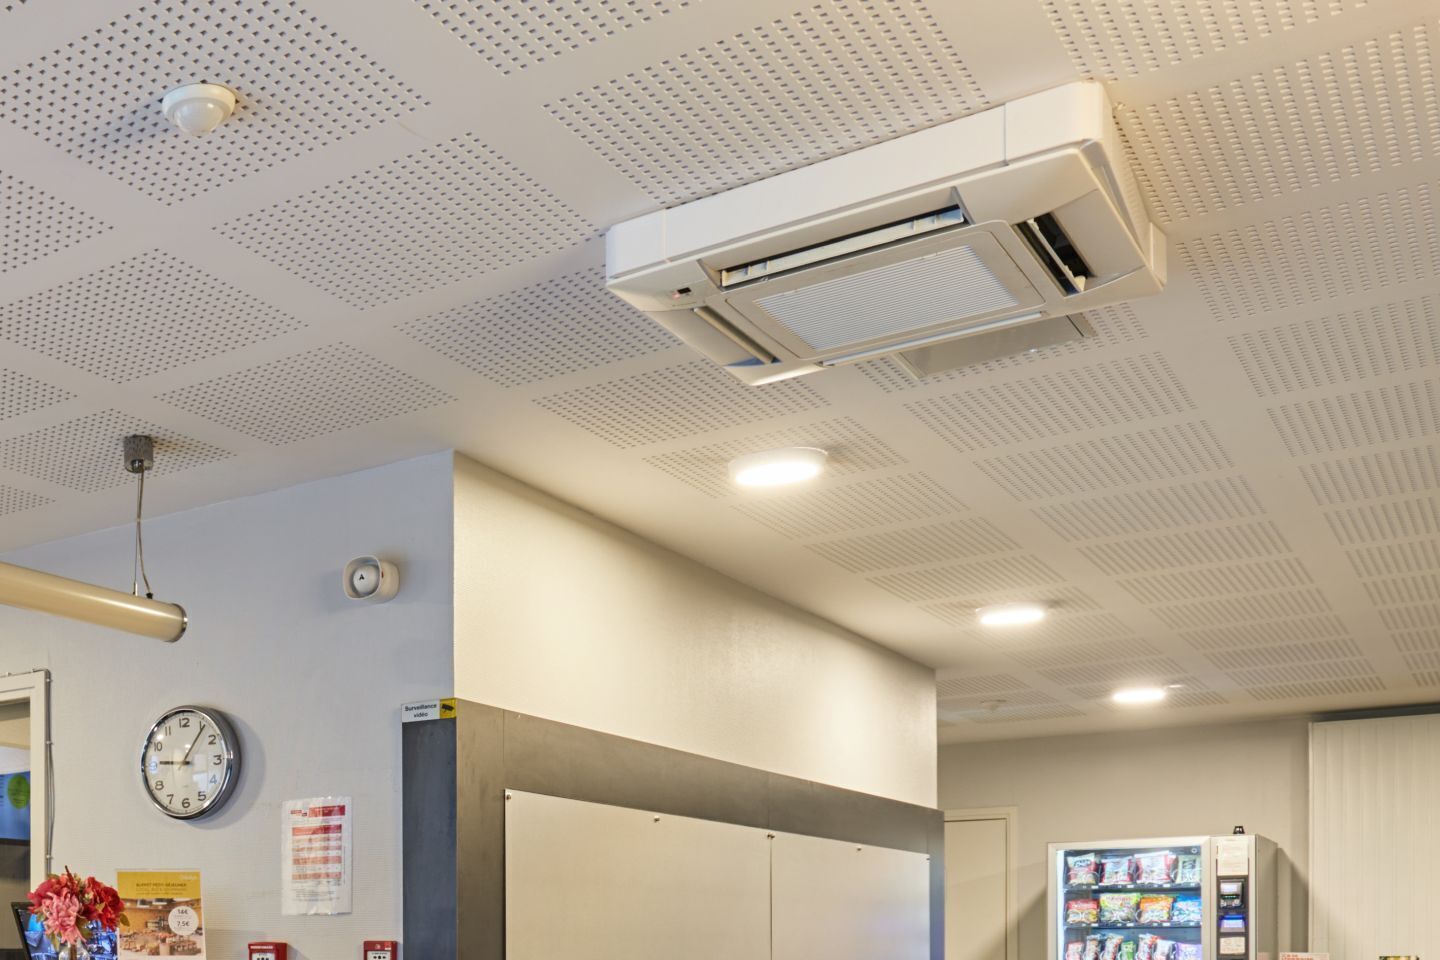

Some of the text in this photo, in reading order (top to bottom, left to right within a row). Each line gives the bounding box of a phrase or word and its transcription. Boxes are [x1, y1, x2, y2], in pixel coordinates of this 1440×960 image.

[179, 717, 190, 728] 12
[165, 726, 171, 736] 11
[208, 734, 217, 745] 2
[153, 741, 163, 752] 10
[213, 754, 222, 766] 3
[149, 761, 158, 772] 9
[209, 774, 217, 784] 4
[155, 780, 164, 791] 8
[166, 794, 174, 804] 7
[197, 791, 207, 801] 5
[181, 798, 191, 808] 6
